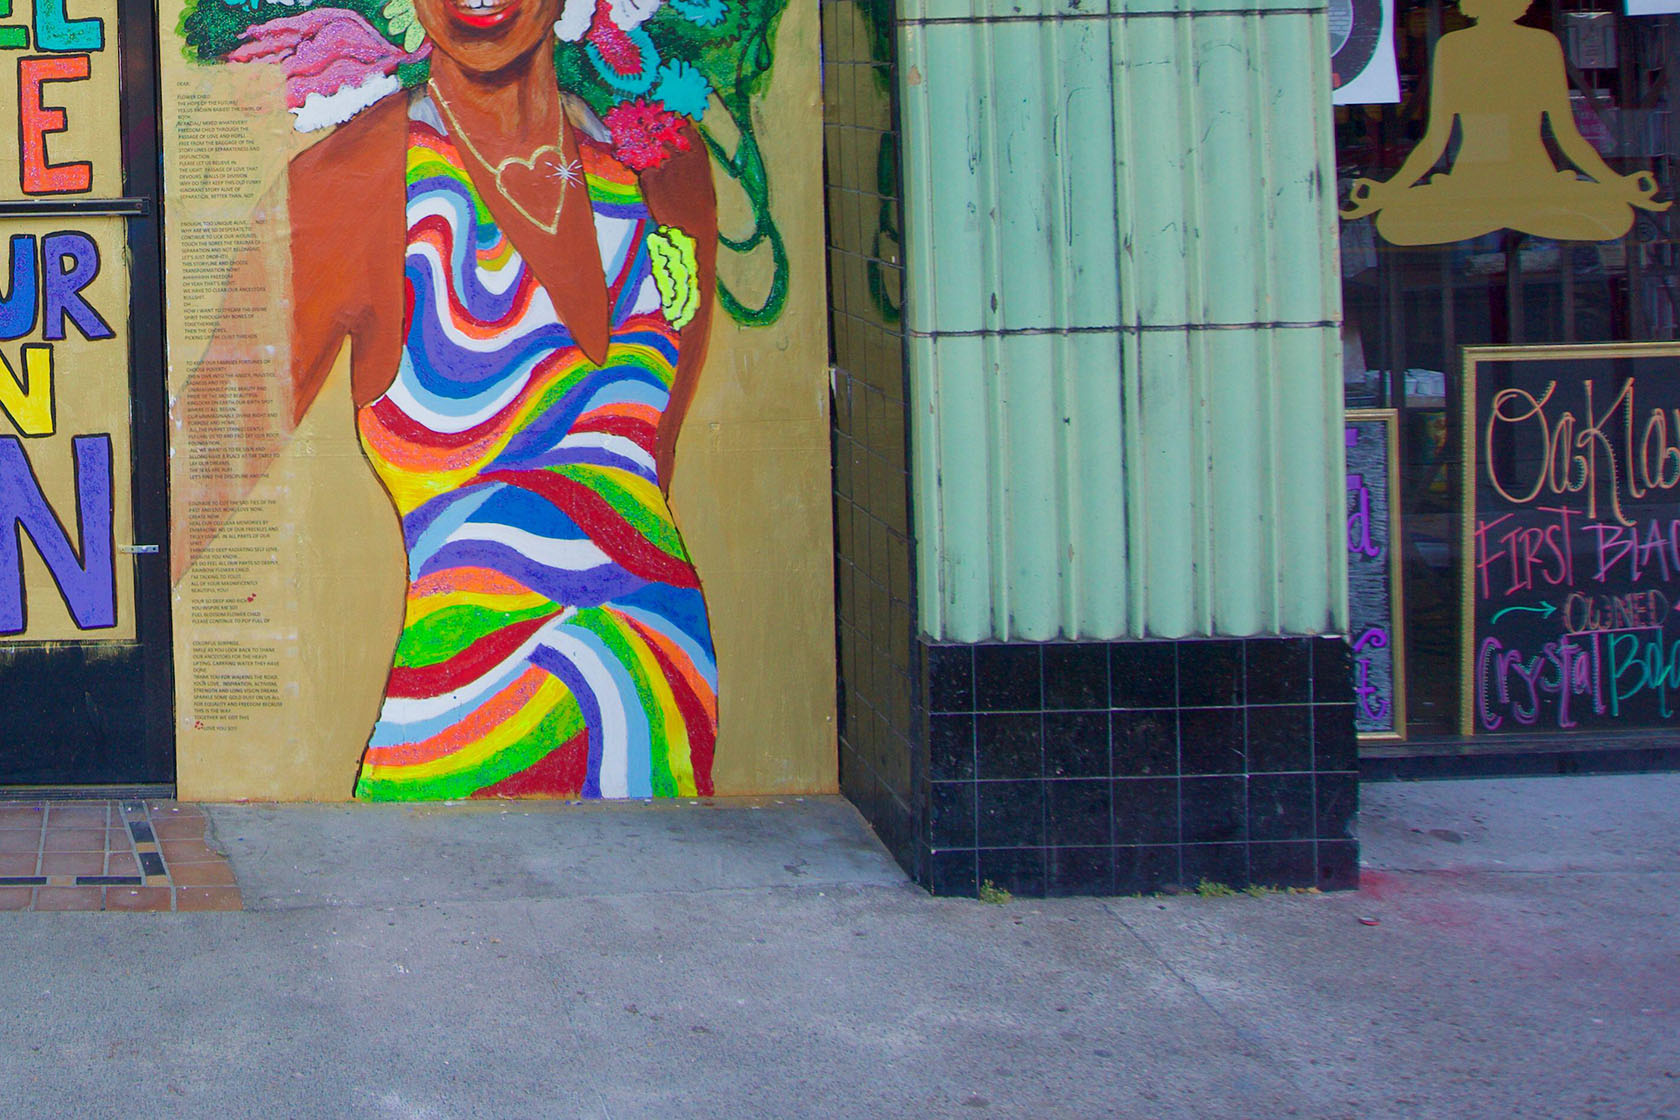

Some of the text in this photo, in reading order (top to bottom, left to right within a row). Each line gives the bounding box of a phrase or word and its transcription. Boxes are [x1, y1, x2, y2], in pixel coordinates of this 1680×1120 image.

[1475, 505, 1582, 599] FIRST
[1564, 589, 1669, 633] OWNED
[1478, 631, 1606, 729] Crystal
